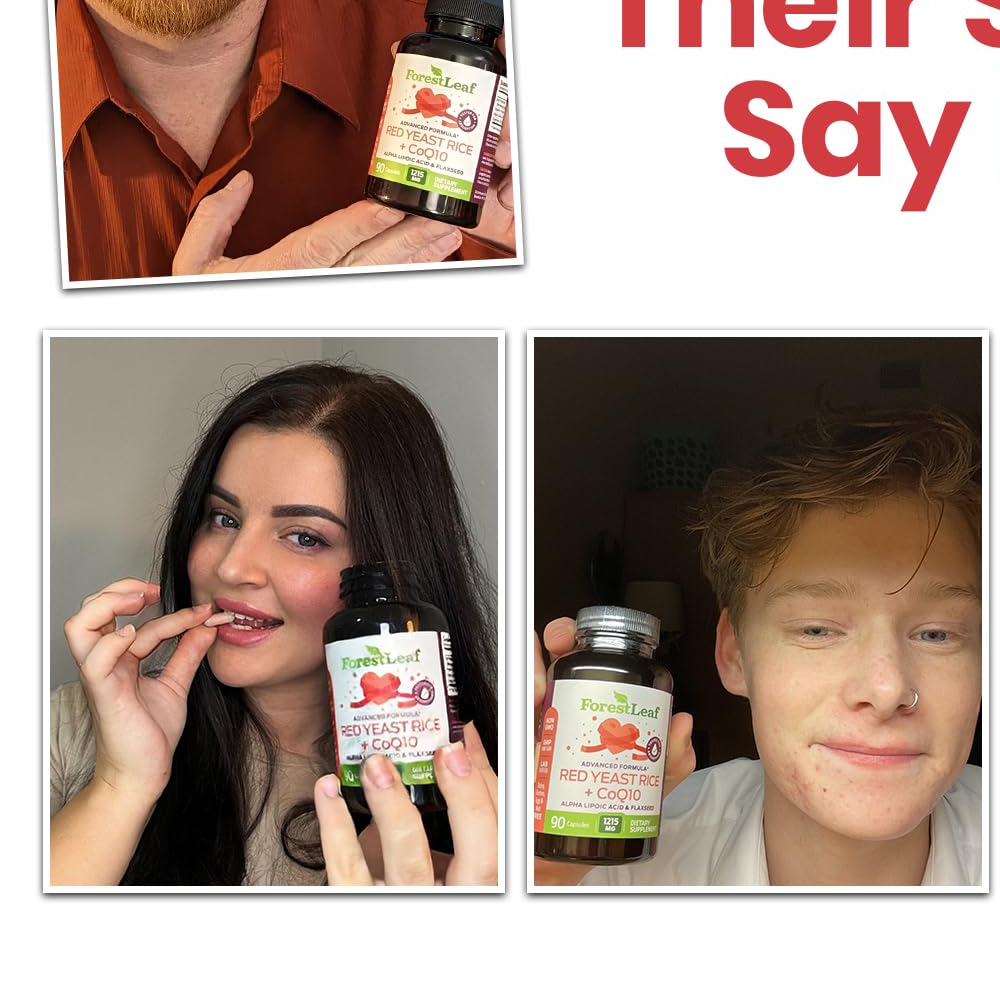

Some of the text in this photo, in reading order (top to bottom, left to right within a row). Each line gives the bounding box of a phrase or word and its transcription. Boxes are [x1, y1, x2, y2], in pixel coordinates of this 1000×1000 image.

[406, 69, 477, 95] ForestLeaf
[400, 120, 428, 132] ADVANCED
[386, 125, 474, 156] RED YEAST RICE
[400, 143, 448, 162] + CoQ10
[376, 162, 385, 173] 90
[411, 169, 425, 178] 1215
[342, 648, 421, 670] ForestLeaf
[580, 698, 660, 720] ForestLeaf
[341, 718, 441, 736] RED YEAST RICE
[361, 736, 418, 751] + CoQ10
[581, 761, 619, 769] ADVANCED
[344, 770, 354, 782] 90
[560, 769, 588, 781] RED
[591, 771, 638, 785] YEAST
[639, 774, 660, 787] RICE
[585, 788, 641, 803] + CoQ10
[551, 816, 590, 830] 90 Capsules
[604, 818, 619, 826] 1215
